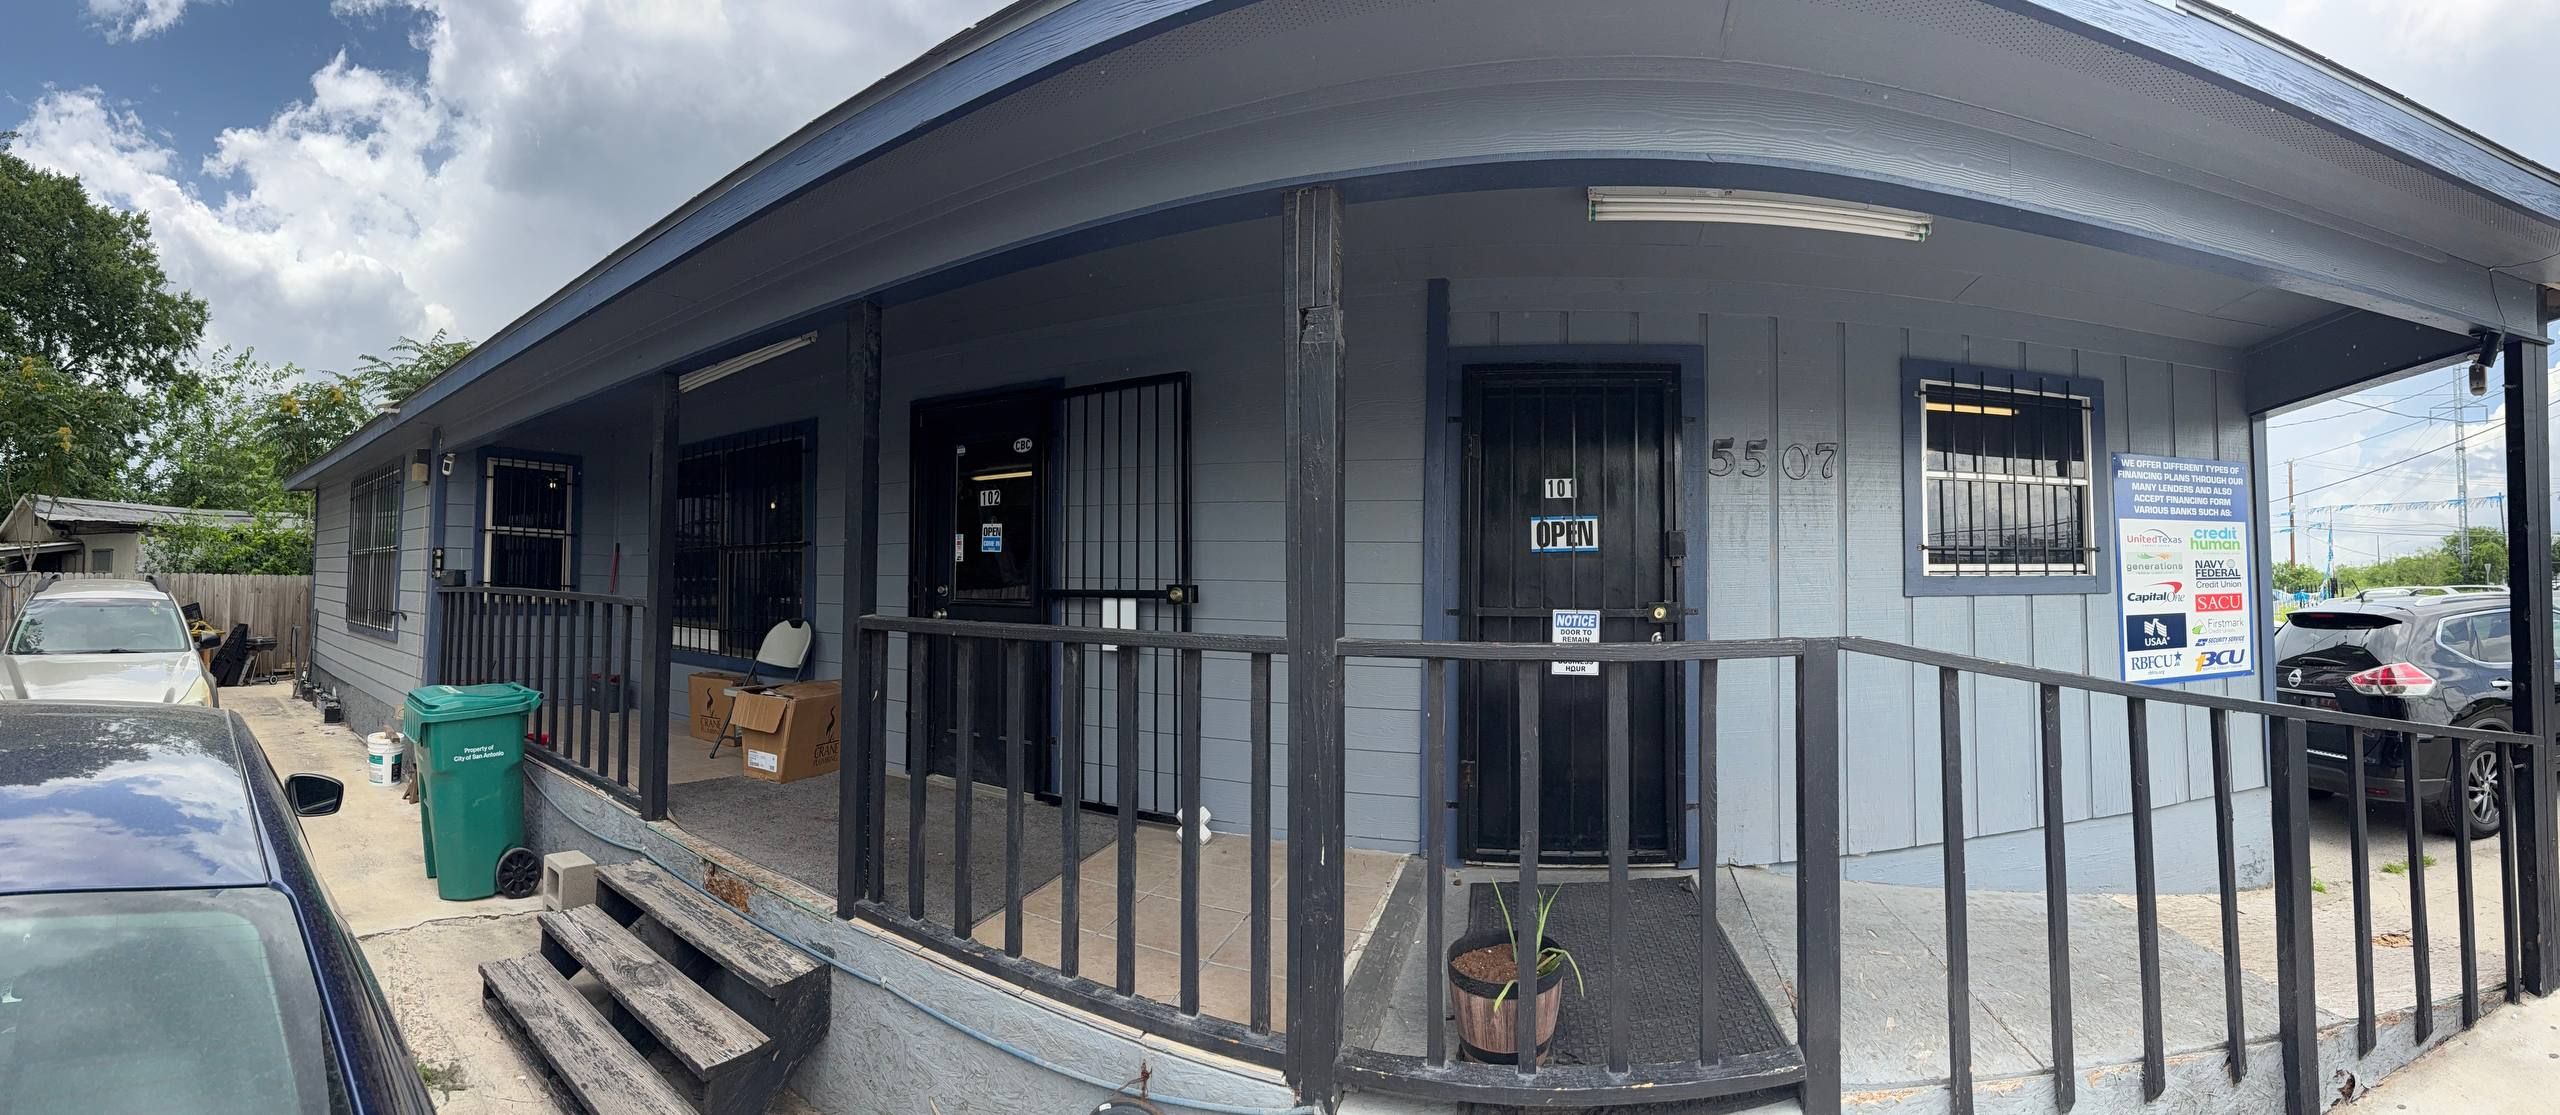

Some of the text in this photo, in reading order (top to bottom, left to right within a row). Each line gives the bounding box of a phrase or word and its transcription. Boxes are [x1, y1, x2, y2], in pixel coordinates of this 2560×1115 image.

[1015, 439, 1032, 451] CBC
[1709, 437, 1839, 480] 5507
[2121, 458, 2240, 474] WE OFFER DIFFERENT TYPES OF
[2117, 469, 2244, 485] FINANCING PLANS THROUGH OUR
[1548, 480, 1575, 498] 101
[2131, 482, 2233, 496] MANY LENDERS AND ALSO
[982, 490, 1000, 505] 102
[2134, 494, 2232, 506] ACCEPT FINANCING FORM
[2133, 505, 2233, 517] VARIOUS BANKS SUCH AS:
[983, 527, 1002, 537] OPEN
[1536, 521, 1594, 548] OPEN
[2193, 527, 2237, 539] credit
[2190, 537, 2241, 550] human
[2126, 562, 2183, 572] generations
[2195, 560, 2224, 568] NAVY
[2195, 568, 2241, 577] FEDERAL
[2196, 580, 2242, 589] Credit Union
[2197, 595, 2241, 610] SACU
[1556, 614, 1596, 627] NOTICE
[2208, 617, 2244, 628] Firstmark
[2144, 637, 2168, 647] USAA
[2131, 654, 2173, 670] RBFCU
[464, 746, 487, 754] Property
[483, 750, 504, 758] Antonio
